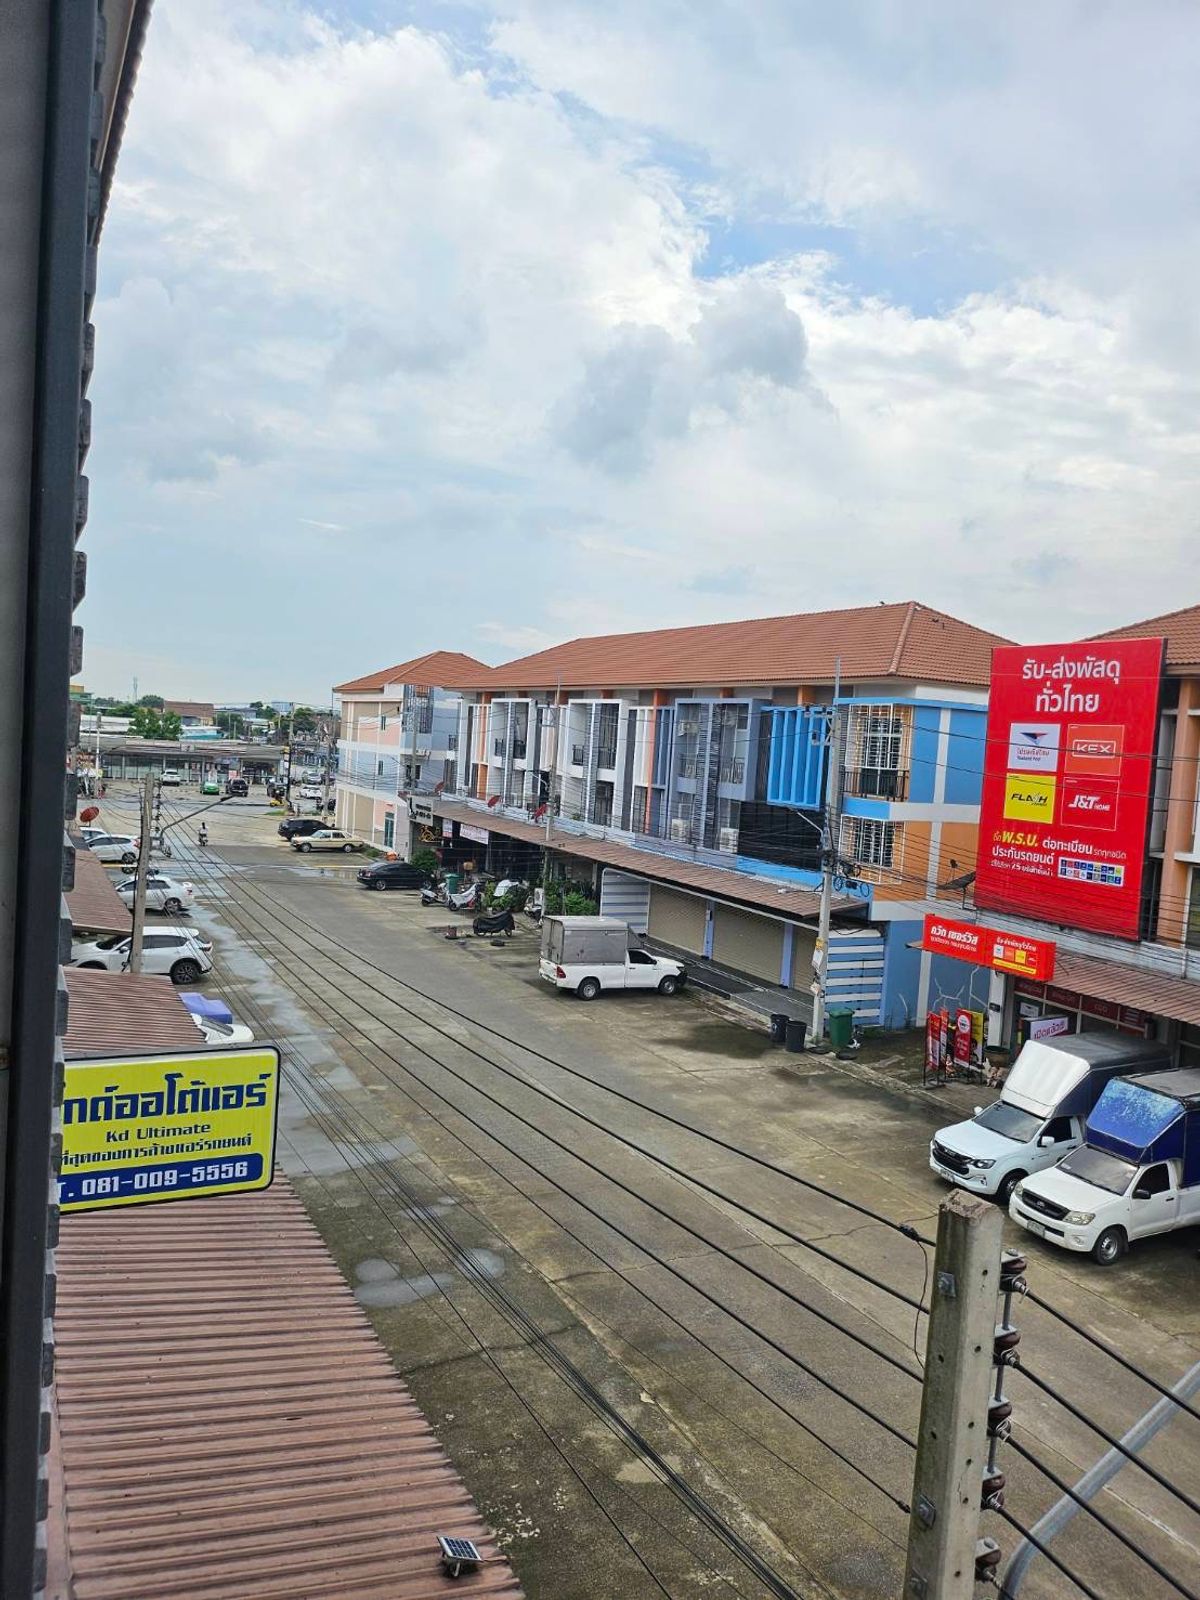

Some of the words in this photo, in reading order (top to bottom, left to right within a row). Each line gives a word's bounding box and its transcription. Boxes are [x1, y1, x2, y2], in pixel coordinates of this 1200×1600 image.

[1021, 655, 1121, 685] รับ-ส่งพัสดุ
[1035, 680, 1100, 713] ทั่วไทย
[1076, 743, 1113, 754] KEX
[991, 846, 1055, 866] ประกันรถยนต์
[1002, 830, 1039, 847] พ.ร.บ.
[1042, 836, 1094, 856] ต่อทะเบียน
[105, 1129, 129, 1143] Kd
[136, 1124, 212, 1141] Ultimate
[81, 1161, 249, 1197] 081-009-5556
